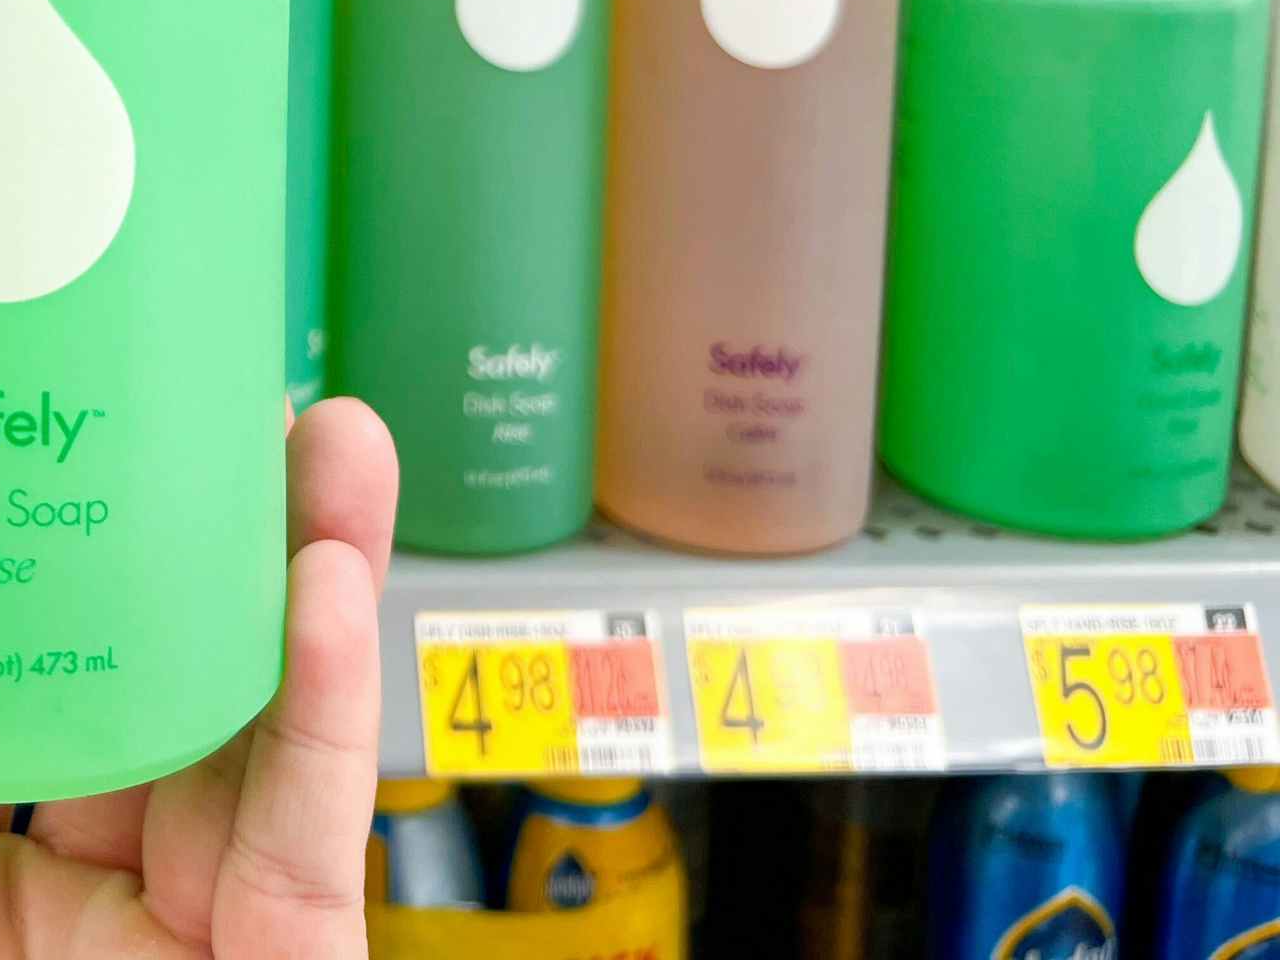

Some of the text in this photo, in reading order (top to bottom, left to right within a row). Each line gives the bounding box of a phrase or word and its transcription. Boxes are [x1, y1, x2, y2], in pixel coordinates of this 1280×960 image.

[7, 489, 108, 536] Soap
[30, 650, 79, 676] 473
[85, 646, 119, 672] mL
